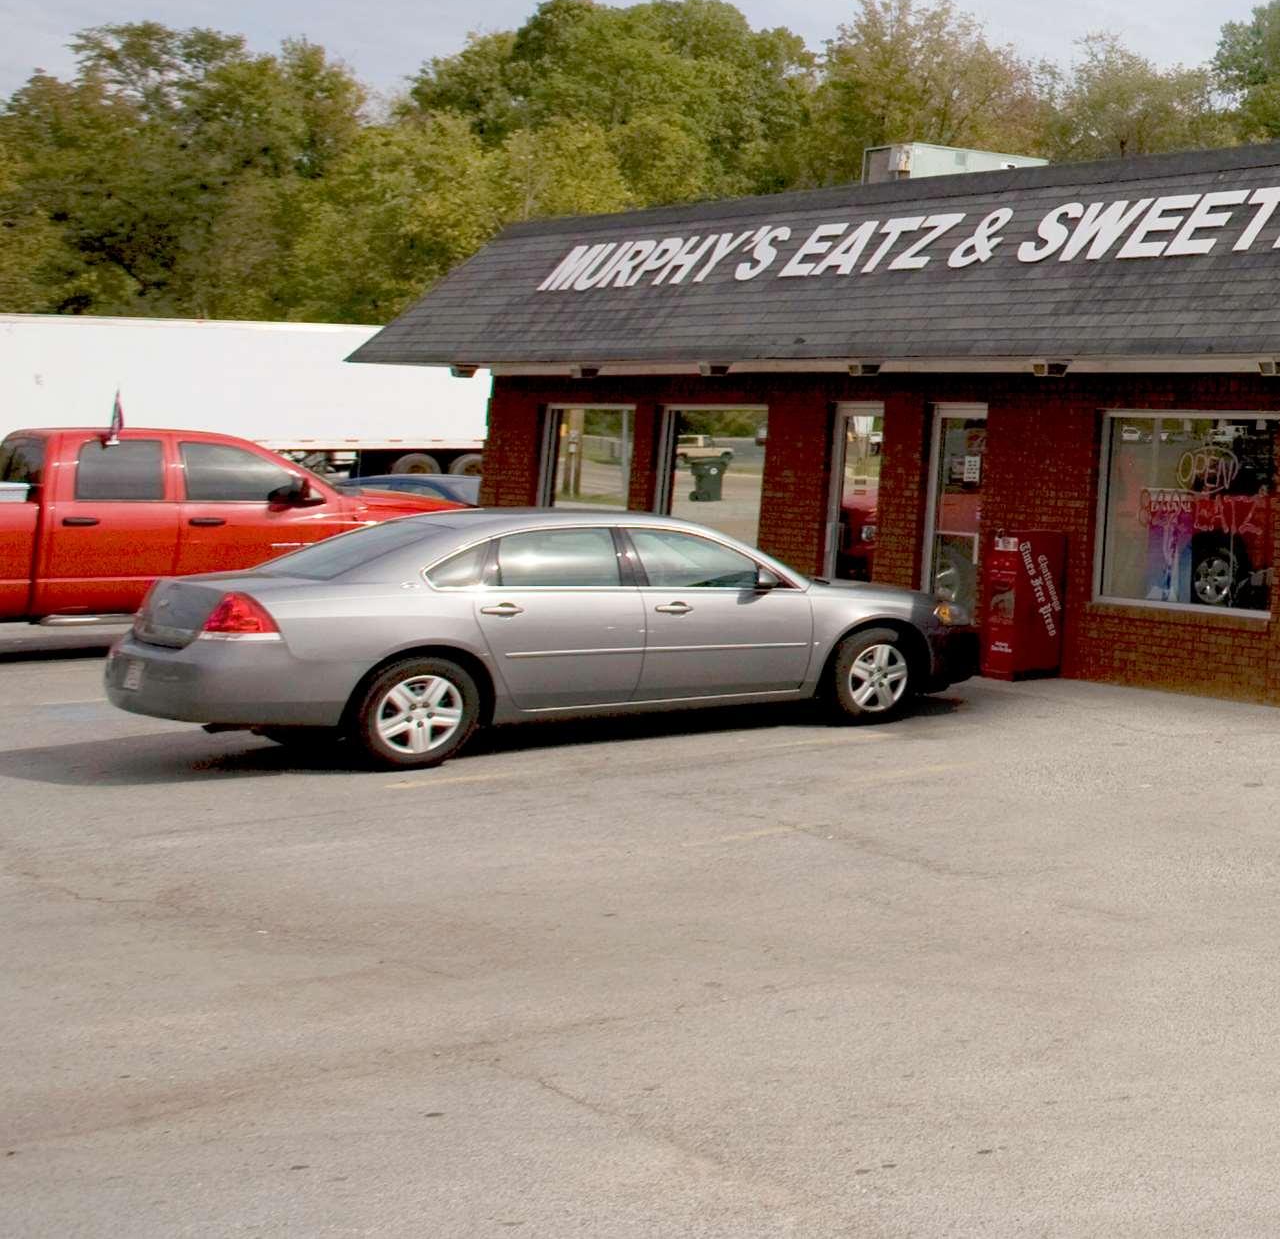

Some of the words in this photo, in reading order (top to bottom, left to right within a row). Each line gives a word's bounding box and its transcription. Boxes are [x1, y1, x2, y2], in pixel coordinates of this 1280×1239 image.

[536, 225, 792, 292] MURPHY'S
[779, 213, 966, 278] EATZ
[947, 207, 1014, 269] &
[1178, 451, 1235, 490] OPEN
